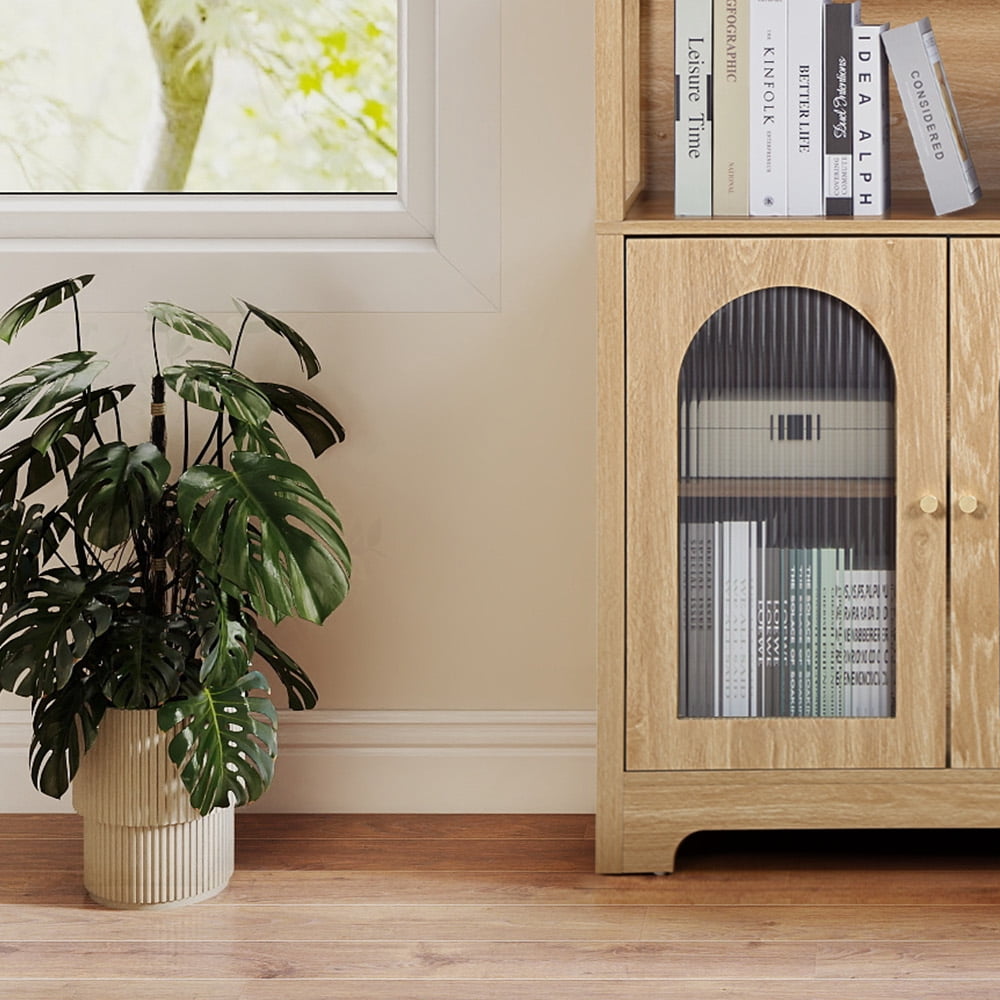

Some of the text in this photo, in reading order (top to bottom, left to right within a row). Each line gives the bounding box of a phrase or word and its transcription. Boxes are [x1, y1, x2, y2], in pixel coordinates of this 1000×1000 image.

[688, 38, 706, 159] Leisure Time
[762, 47, 775, 125] KINFOLK
[799, 65, 810, 153] BETTER LIFE
[910, 70, 945, 161] CONSIDERED
